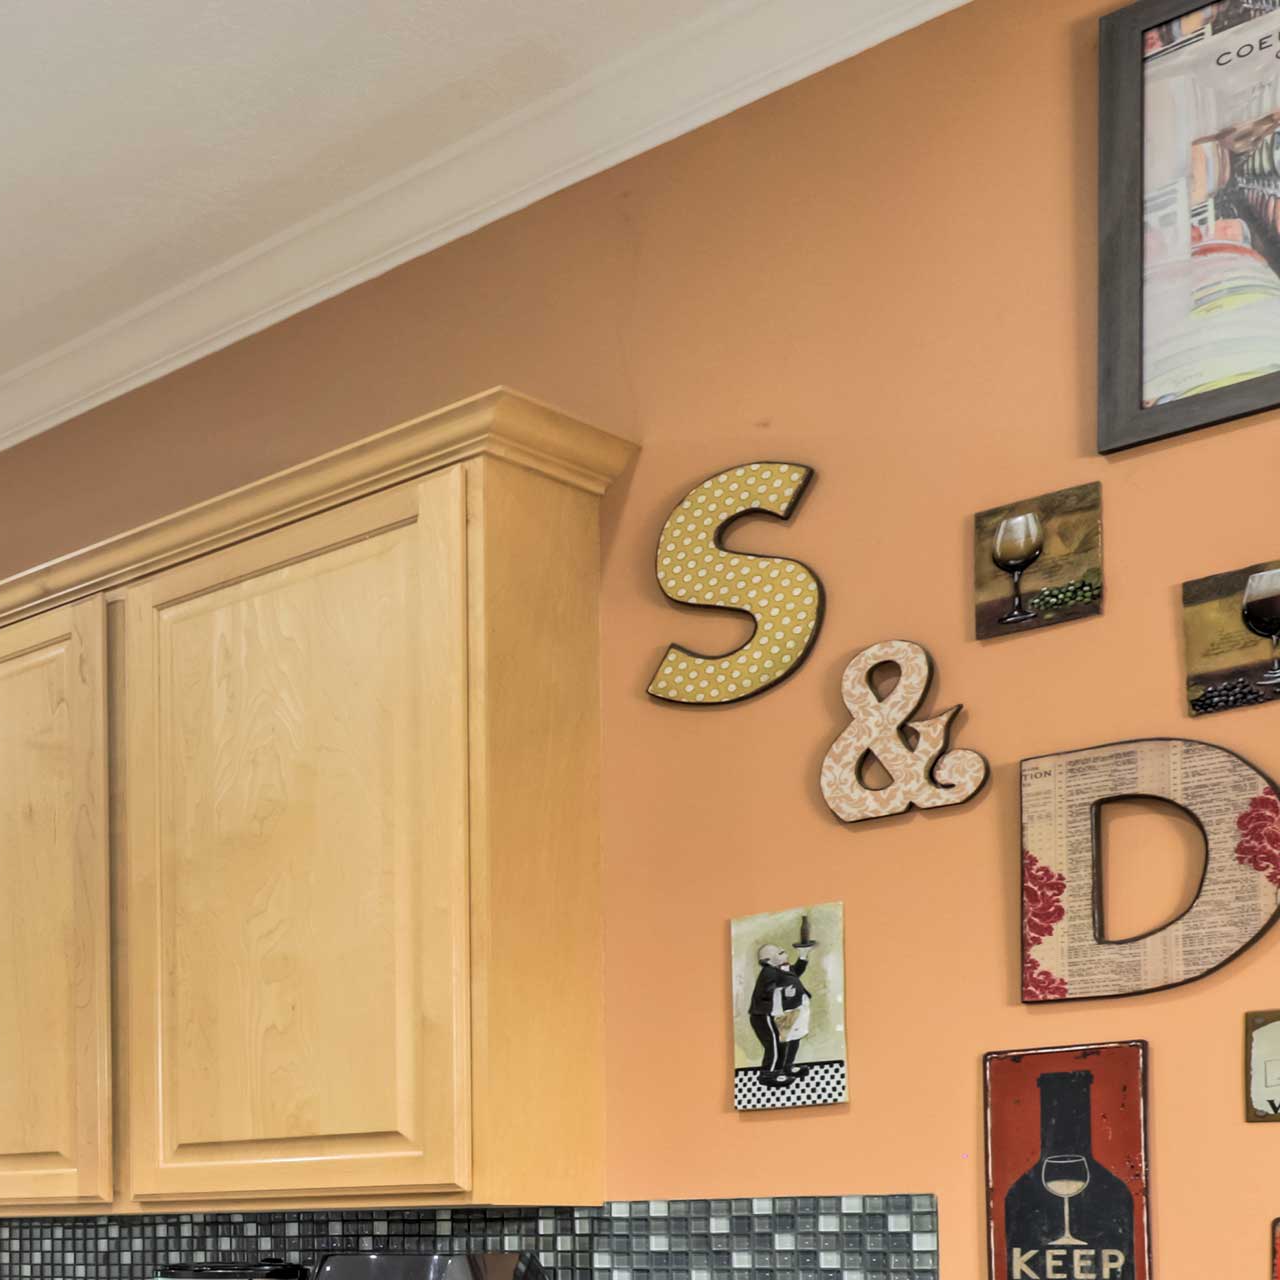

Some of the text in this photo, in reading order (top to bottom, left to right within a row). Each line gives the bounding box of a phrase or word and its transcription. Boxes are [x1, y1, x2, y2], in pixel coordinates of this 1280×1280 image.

[1215, 31, 1280, 67] COE
[647, 461, 826, 707] S
[820, 640, 991, 823] &
[1020, 738, 1280, 1003] D
[1011, 1247, 1126, 1280] KEEP
